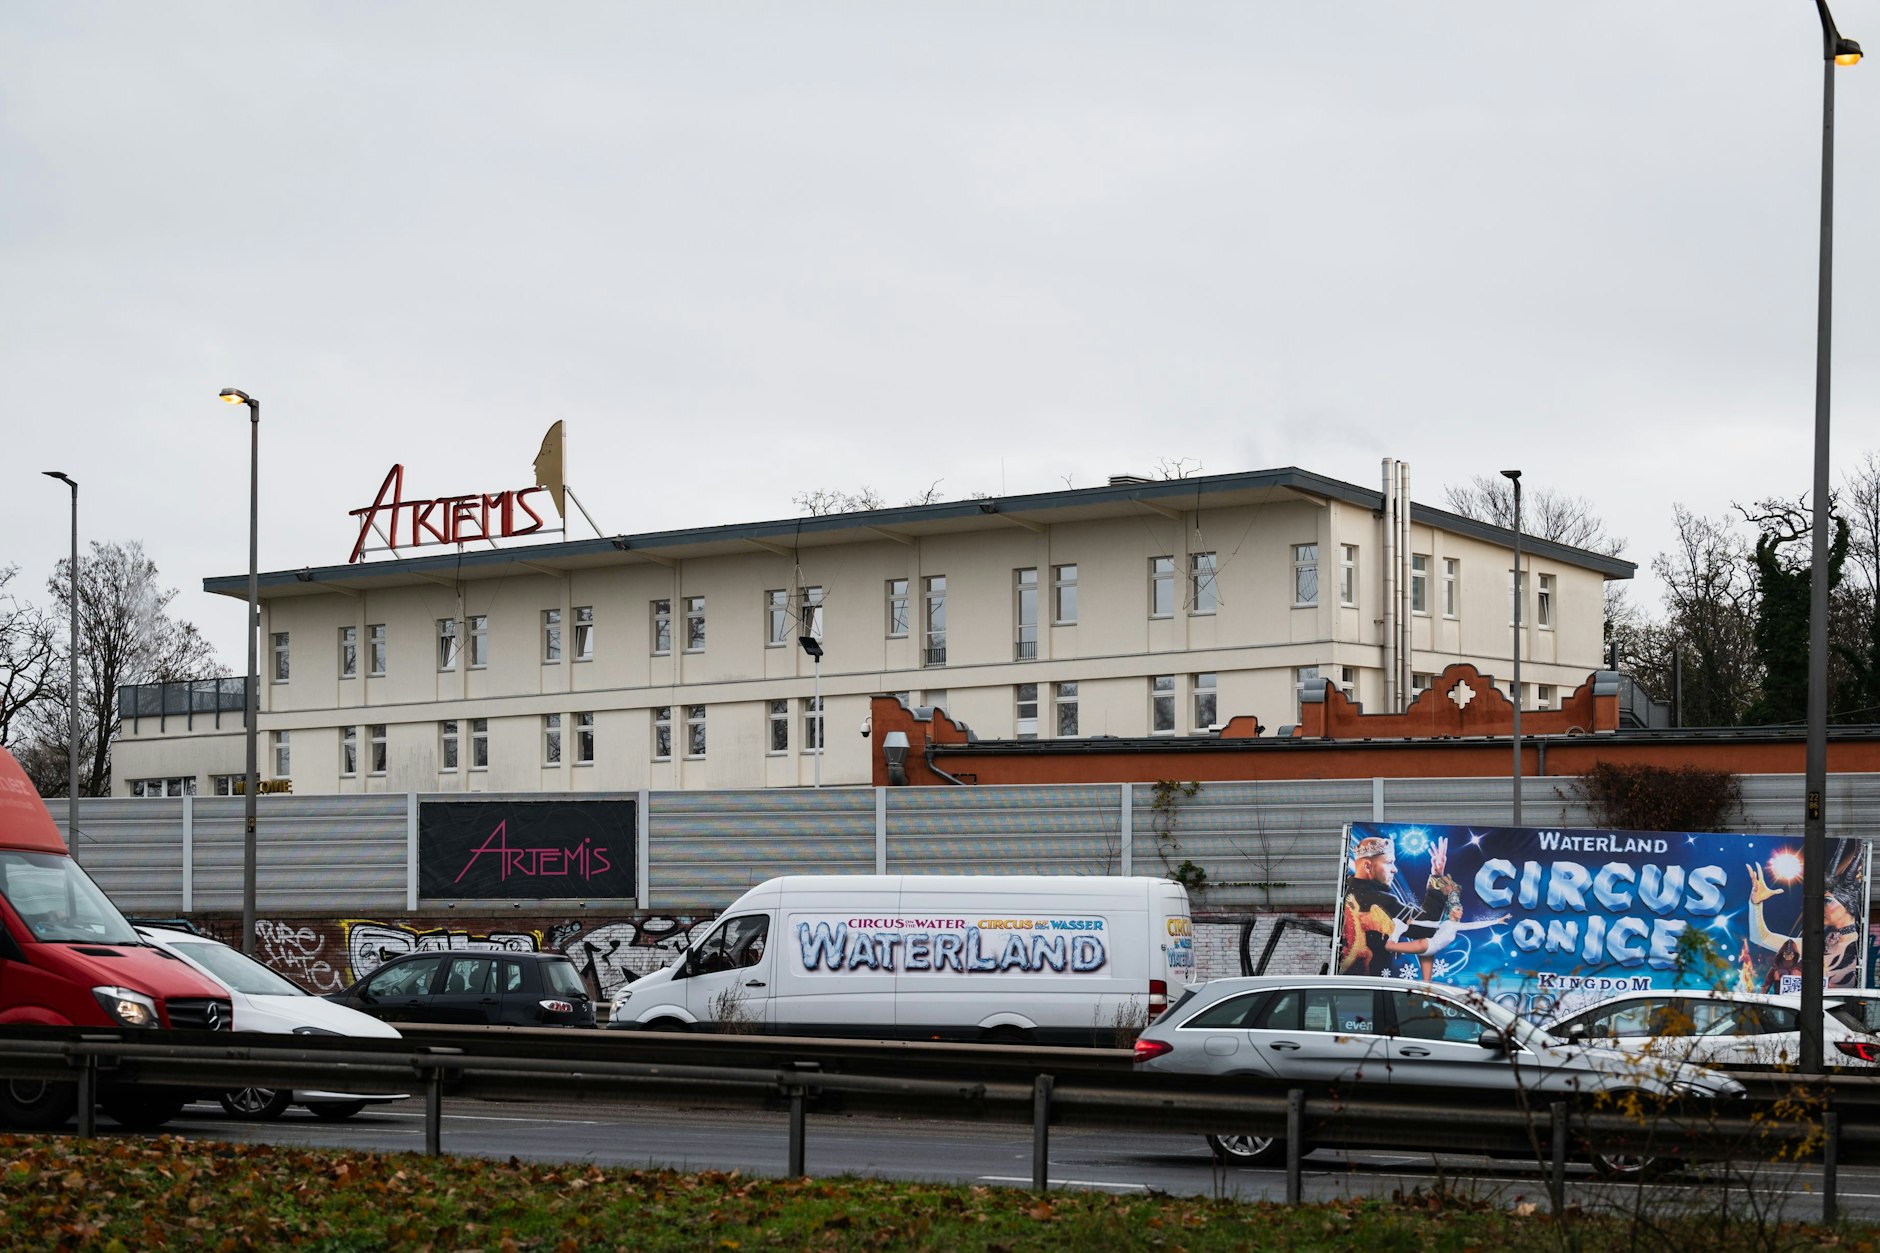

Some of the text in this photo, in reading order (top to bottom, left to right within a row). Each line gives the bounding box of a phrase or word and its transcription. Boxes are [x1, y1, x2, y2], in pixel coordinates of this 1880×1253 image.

[349, 464, 544, 563] ARTEMIS
[454, 818, 611, 884] ARTEMIS
[1538, 832, 1668, 854] WATERLAND
[1474, 858, 1728, 916] CIRCUS
[798, 921, 1107, 972] WATERLAND
[848, 918, 905, 929] CIRCUS
[915, 919, 966, 929] WATER
[977, 919, 1034, 930] CIRCUS
[1050, 920, 1104, 931] WASSER
[1512, 915, 1687, 971] ON ICE
[1538, 973, 1651, 991] KINGDOM
